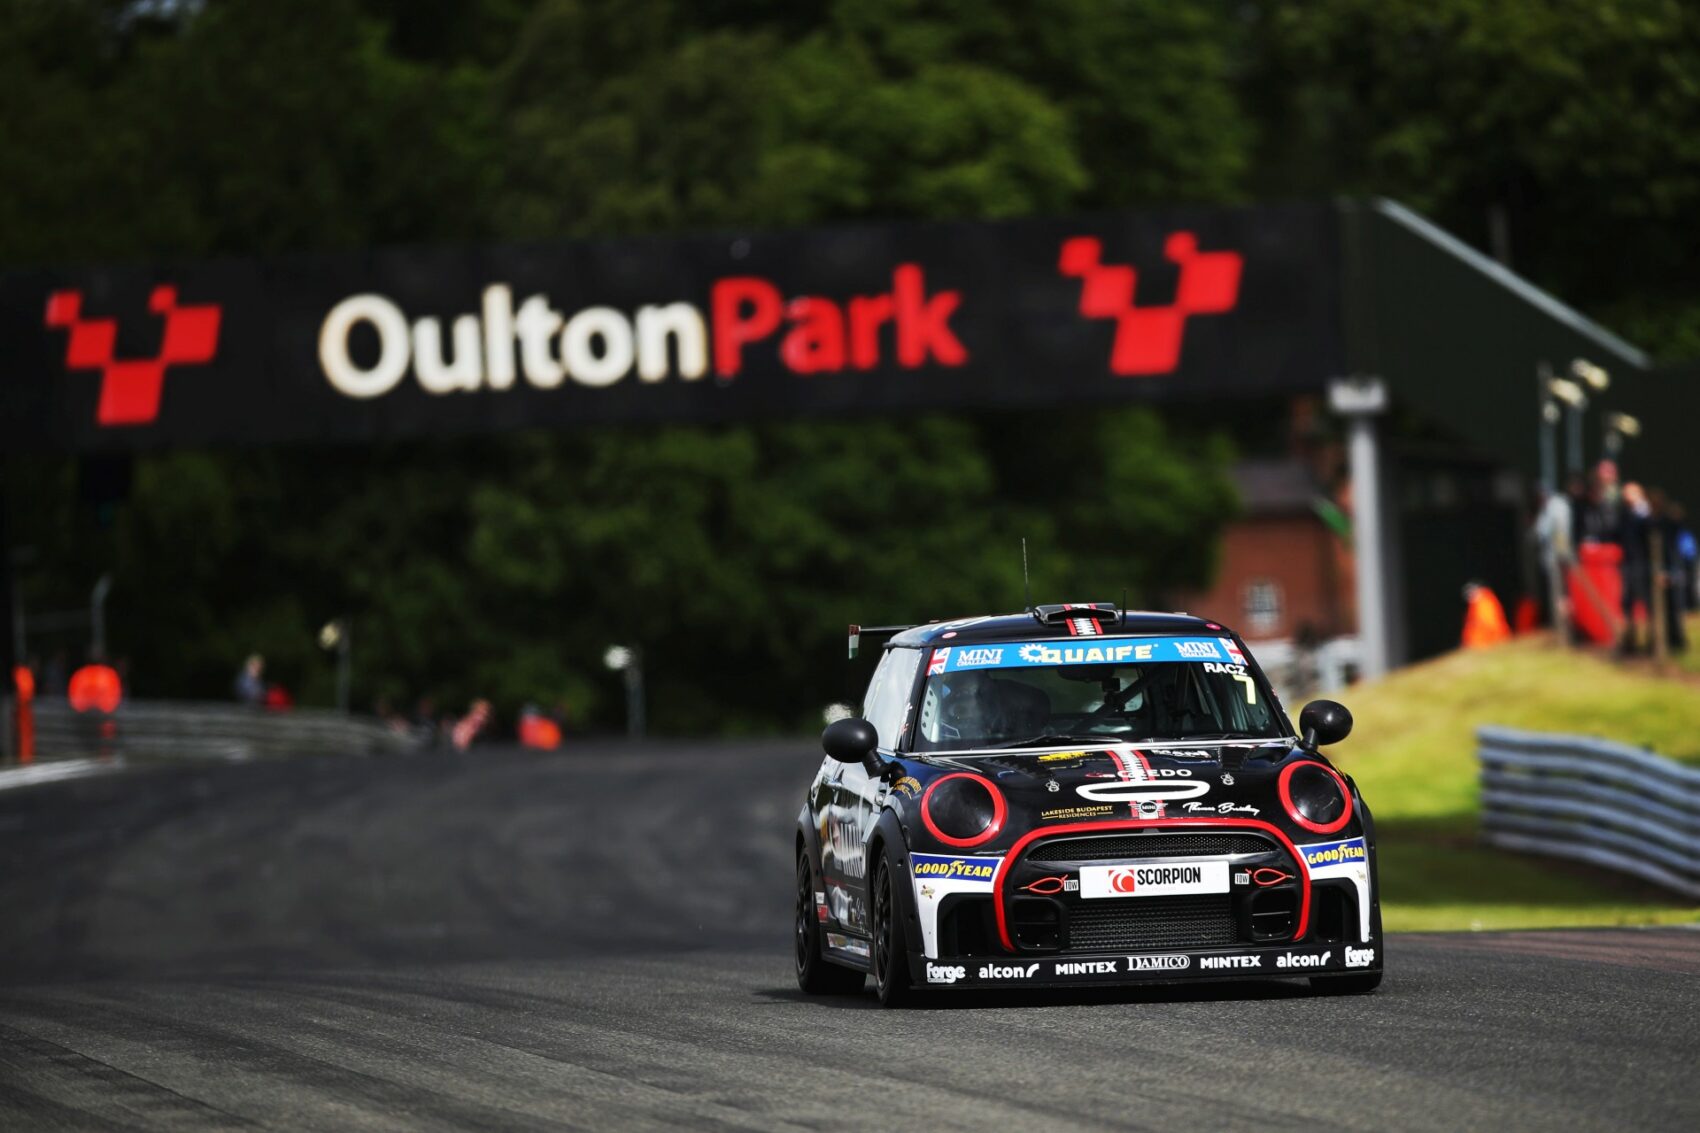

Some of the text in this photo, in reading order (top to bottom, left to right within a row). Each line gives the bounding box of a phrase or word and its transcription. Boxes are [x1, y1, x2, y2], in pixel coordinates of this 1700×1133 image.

[1040, 644, 1153, 664] QUAIFE
[1173, 641, 1216, 653] MINI
[959, 648, 1004, 661] MINI
[1203, 663, 1248, 676] RACZ
[1233, 675, 1256, 704] 7
[1041, 805, 1113, 816] LAKESIDE BUDAPEST
[1058, 811, 1096, 819] RESIDENCES
[915, 860, 993, 878] GOODYEAR
[1137, 867, 1201, 885] SCORPION
[1065, 881, 1078, 890] TOW
[1236, 873, 1248, 884] TOW
[1127, 956, 1190, 971] DAMICO
[1200, 955, 1261, 969] MINTEX
[1276, 952, 1320, 967] alcon
[1345, 946, 1374, 967] forge
[926, 962, 966, 983] forge
[979, 963, 1024, 979] alcon
[1056, 961, 1117, 975] MINTEX
